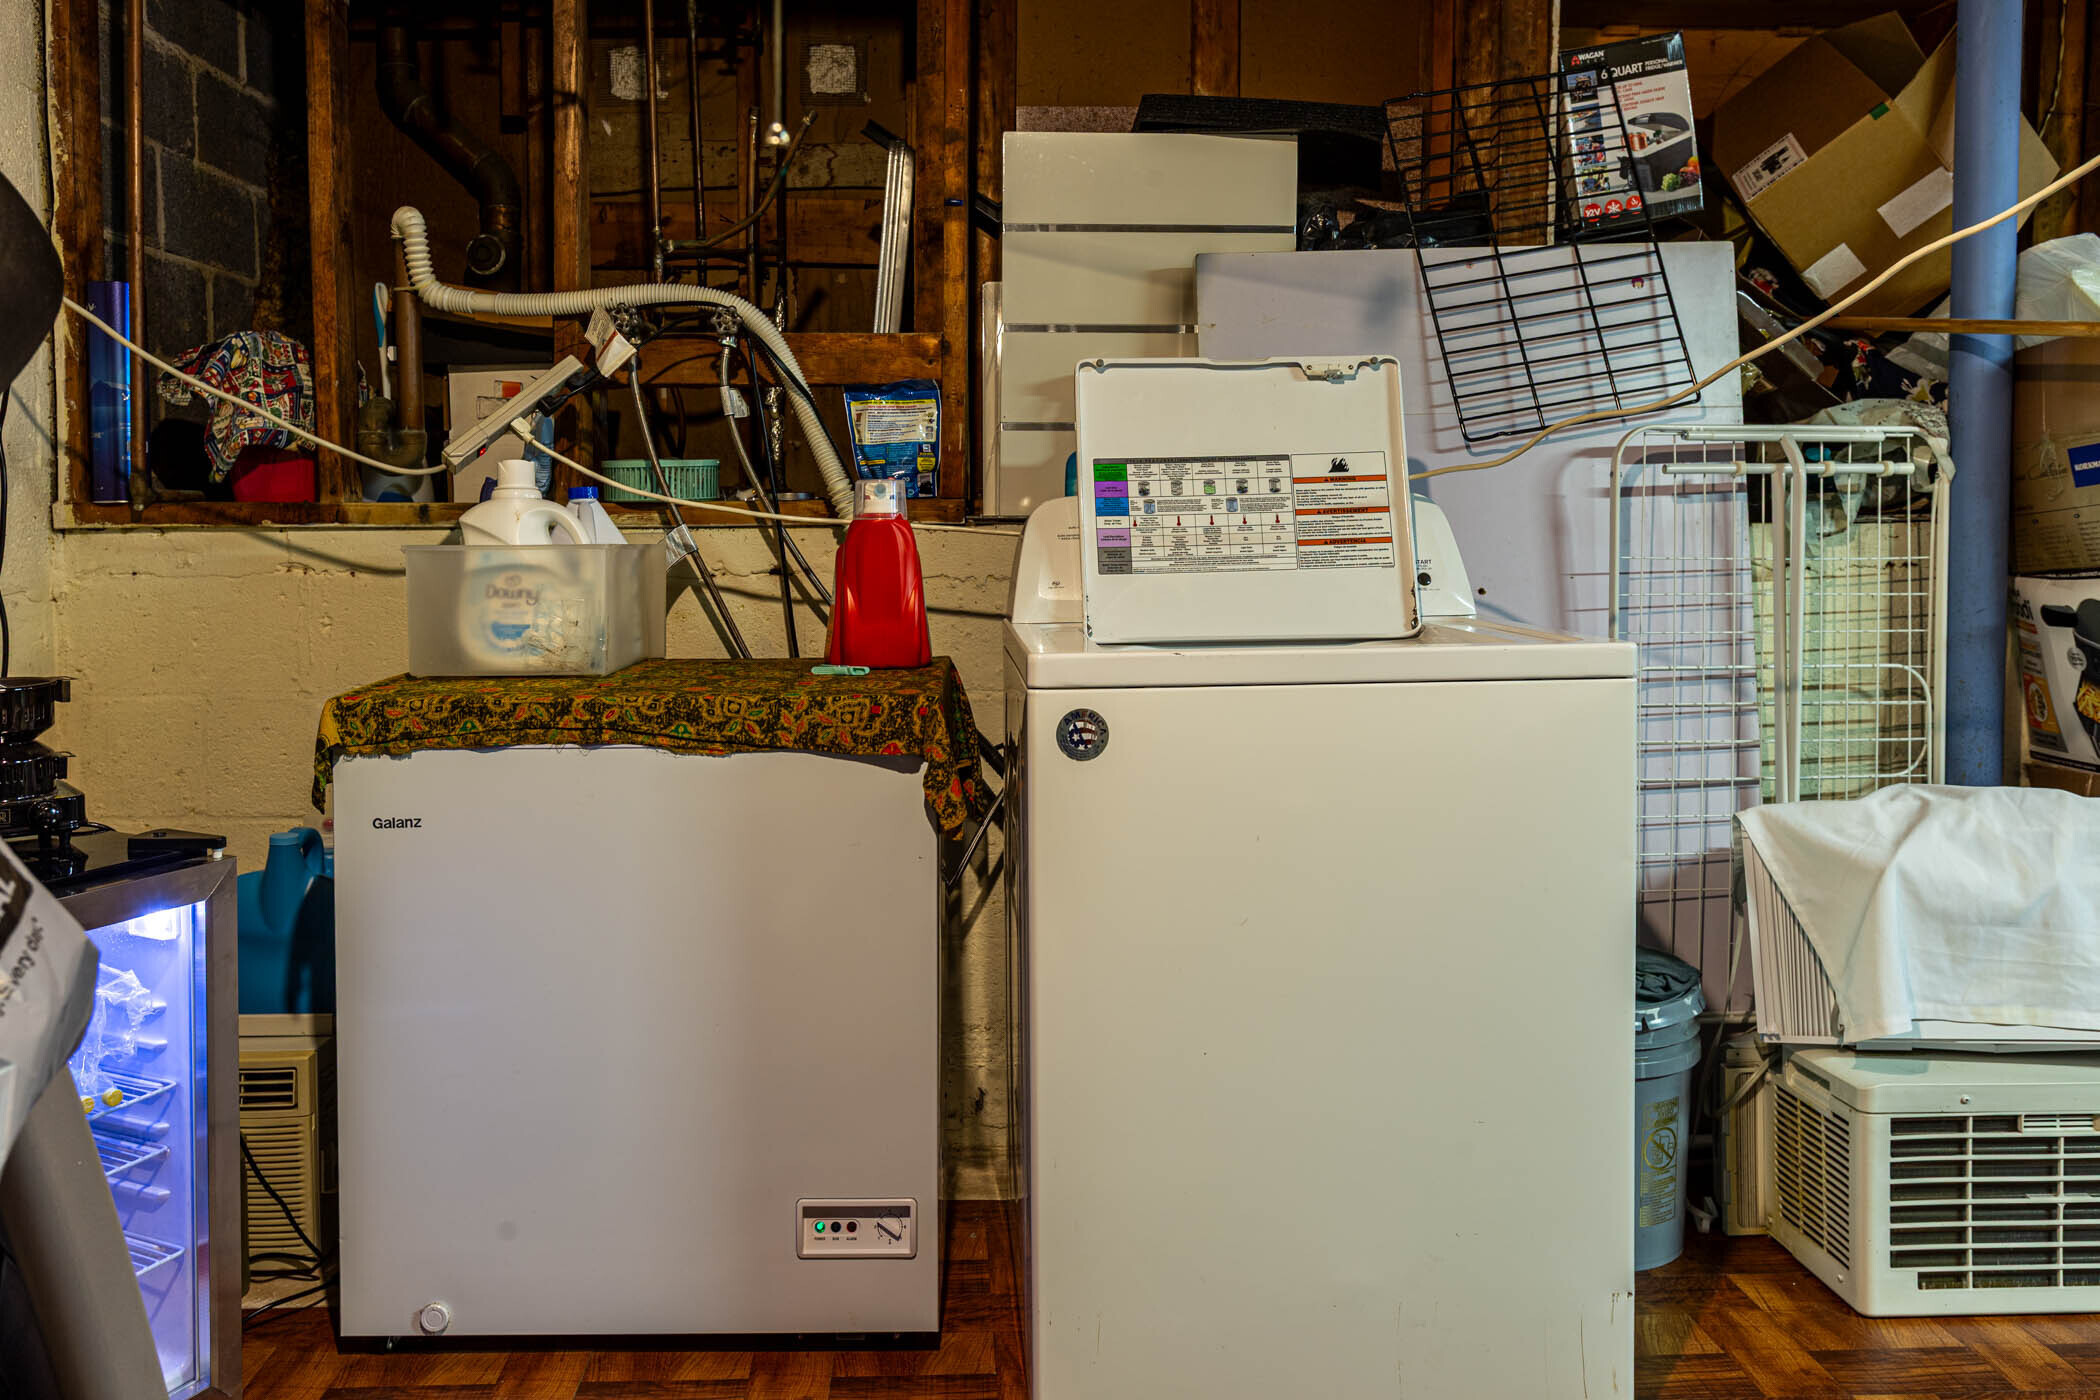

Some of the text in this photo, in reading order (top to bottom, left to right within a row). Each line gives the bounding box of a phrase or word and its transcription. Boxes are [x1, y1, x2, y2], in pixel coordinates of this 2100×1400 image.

[1578, 50, 1605, 61] WAGAN
[1601, 62, 1643, 80] 6 QUART
[1328, 537, 1366, 545] ADVERTENCIA
[485, 583, 543, 606] Downy
[1064, 712, 1106, 736] AMERICA
[372, 817, 422, 829] Galanz
